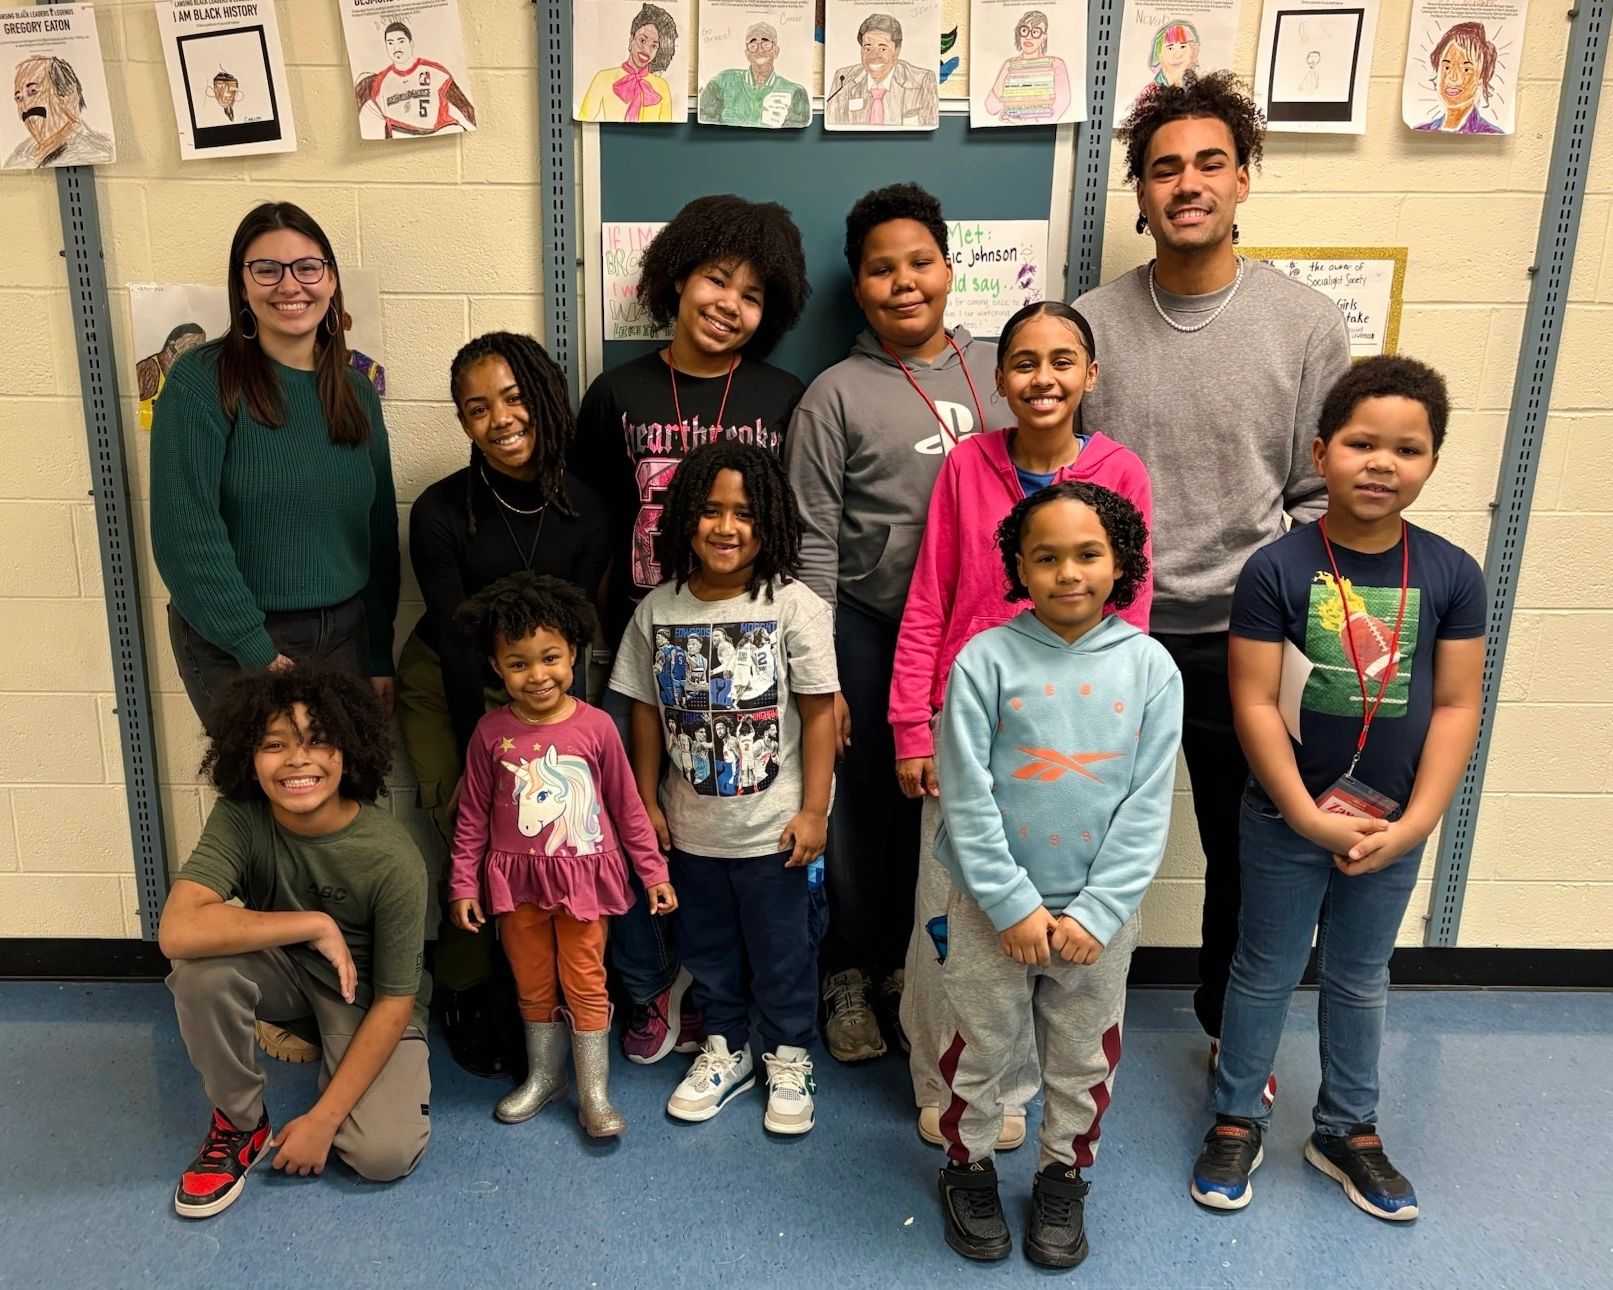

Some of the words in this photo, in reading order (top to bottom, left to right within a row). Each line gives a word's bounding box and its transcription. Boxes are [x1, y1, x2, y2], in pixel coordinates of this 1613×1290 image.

[173, 11, 177, 23] I
[179, 10, 192, 22] AM
[193, 7, 222, 21] BLACK
[223, 4, 258, 19] HISTORY
[4, 21, 42, 35] GREGORY
[44, 19, 71, 32] EATON
[419, 99, 430, 118] 5
[1309, 261, 1324, 272] the
